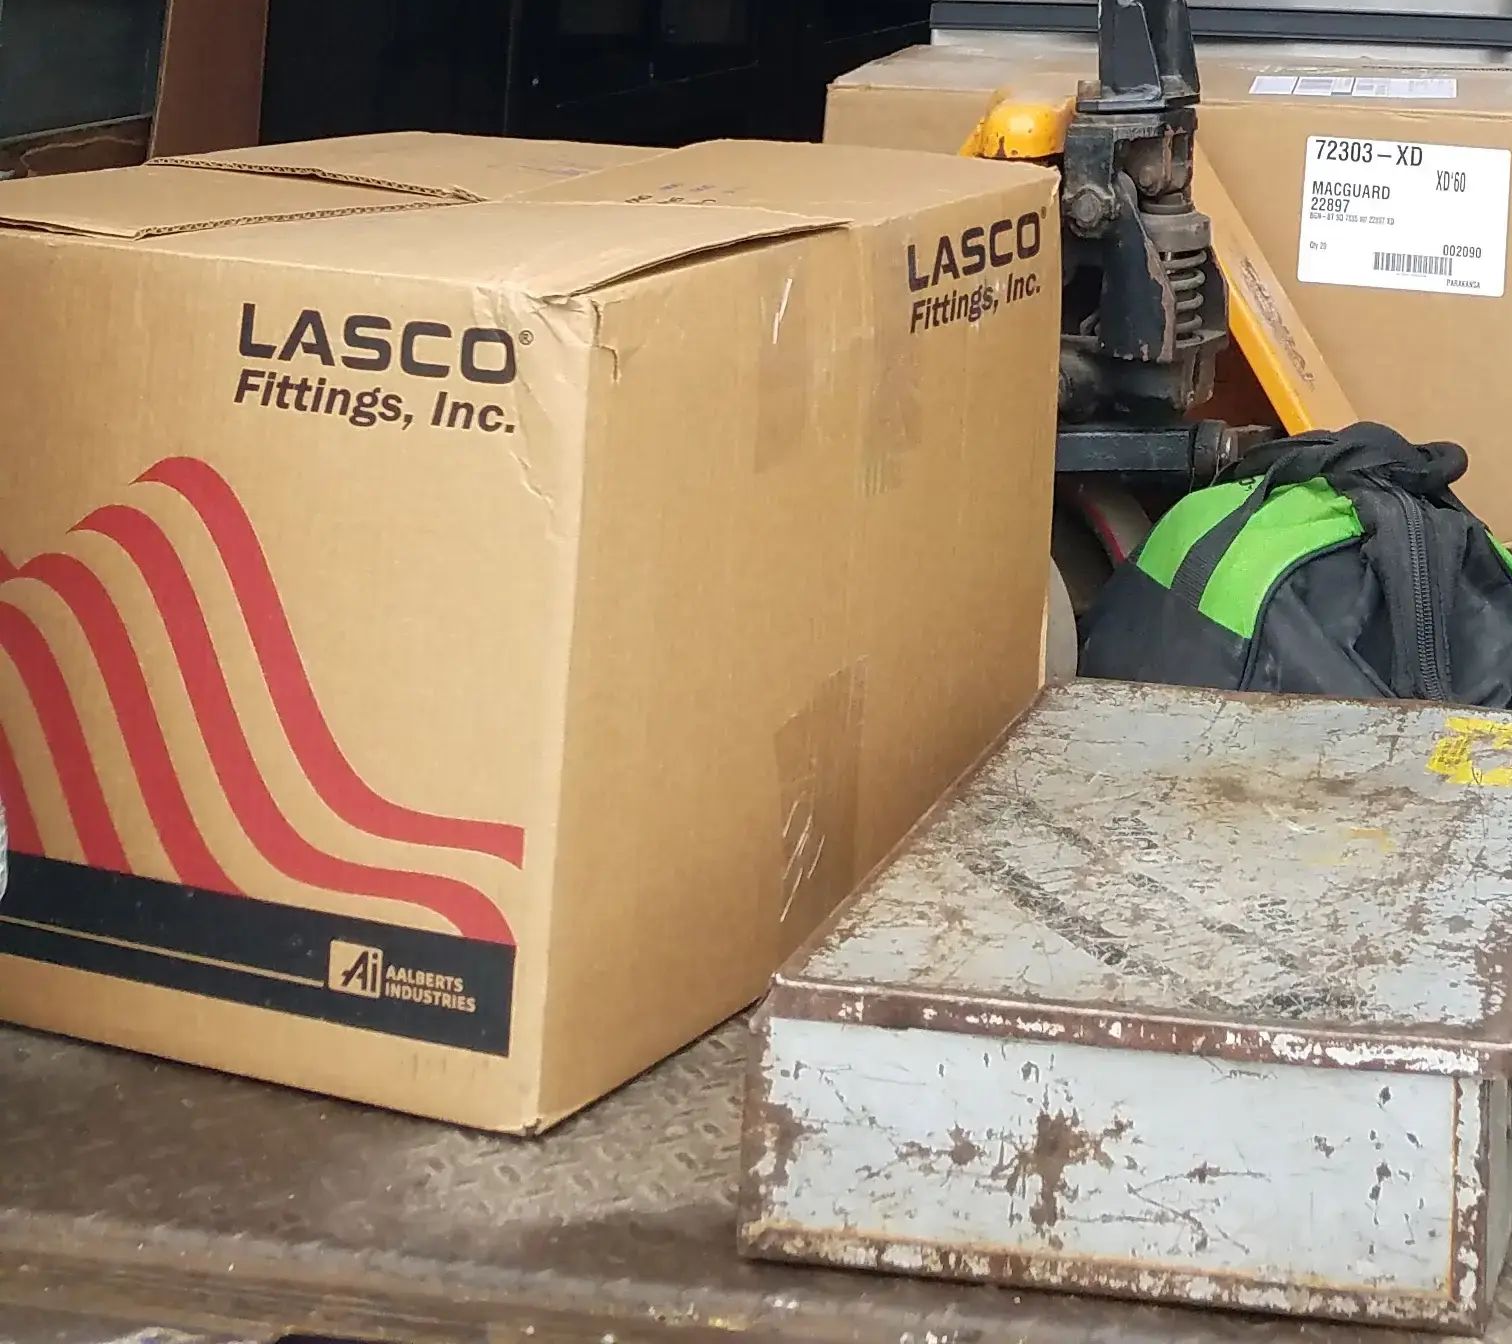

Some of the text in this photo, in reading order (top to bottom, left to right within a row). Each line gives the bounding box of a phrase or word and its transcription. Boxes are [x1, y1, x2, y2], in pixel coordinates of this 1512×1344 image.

[1311, 180, 1391, 200] MACGUARD
[1310, 197, 1350, 213] 22897
[1442, 244, 1482, 259] 002090
[909, 272, 1042, 334] Fittings, Inc.
[233, 368, 517, 434] Fittings, Inc.
[385, 964, 465, 993] AALBERTS
[384, 982, 477, 1013] INDUSTRIES
